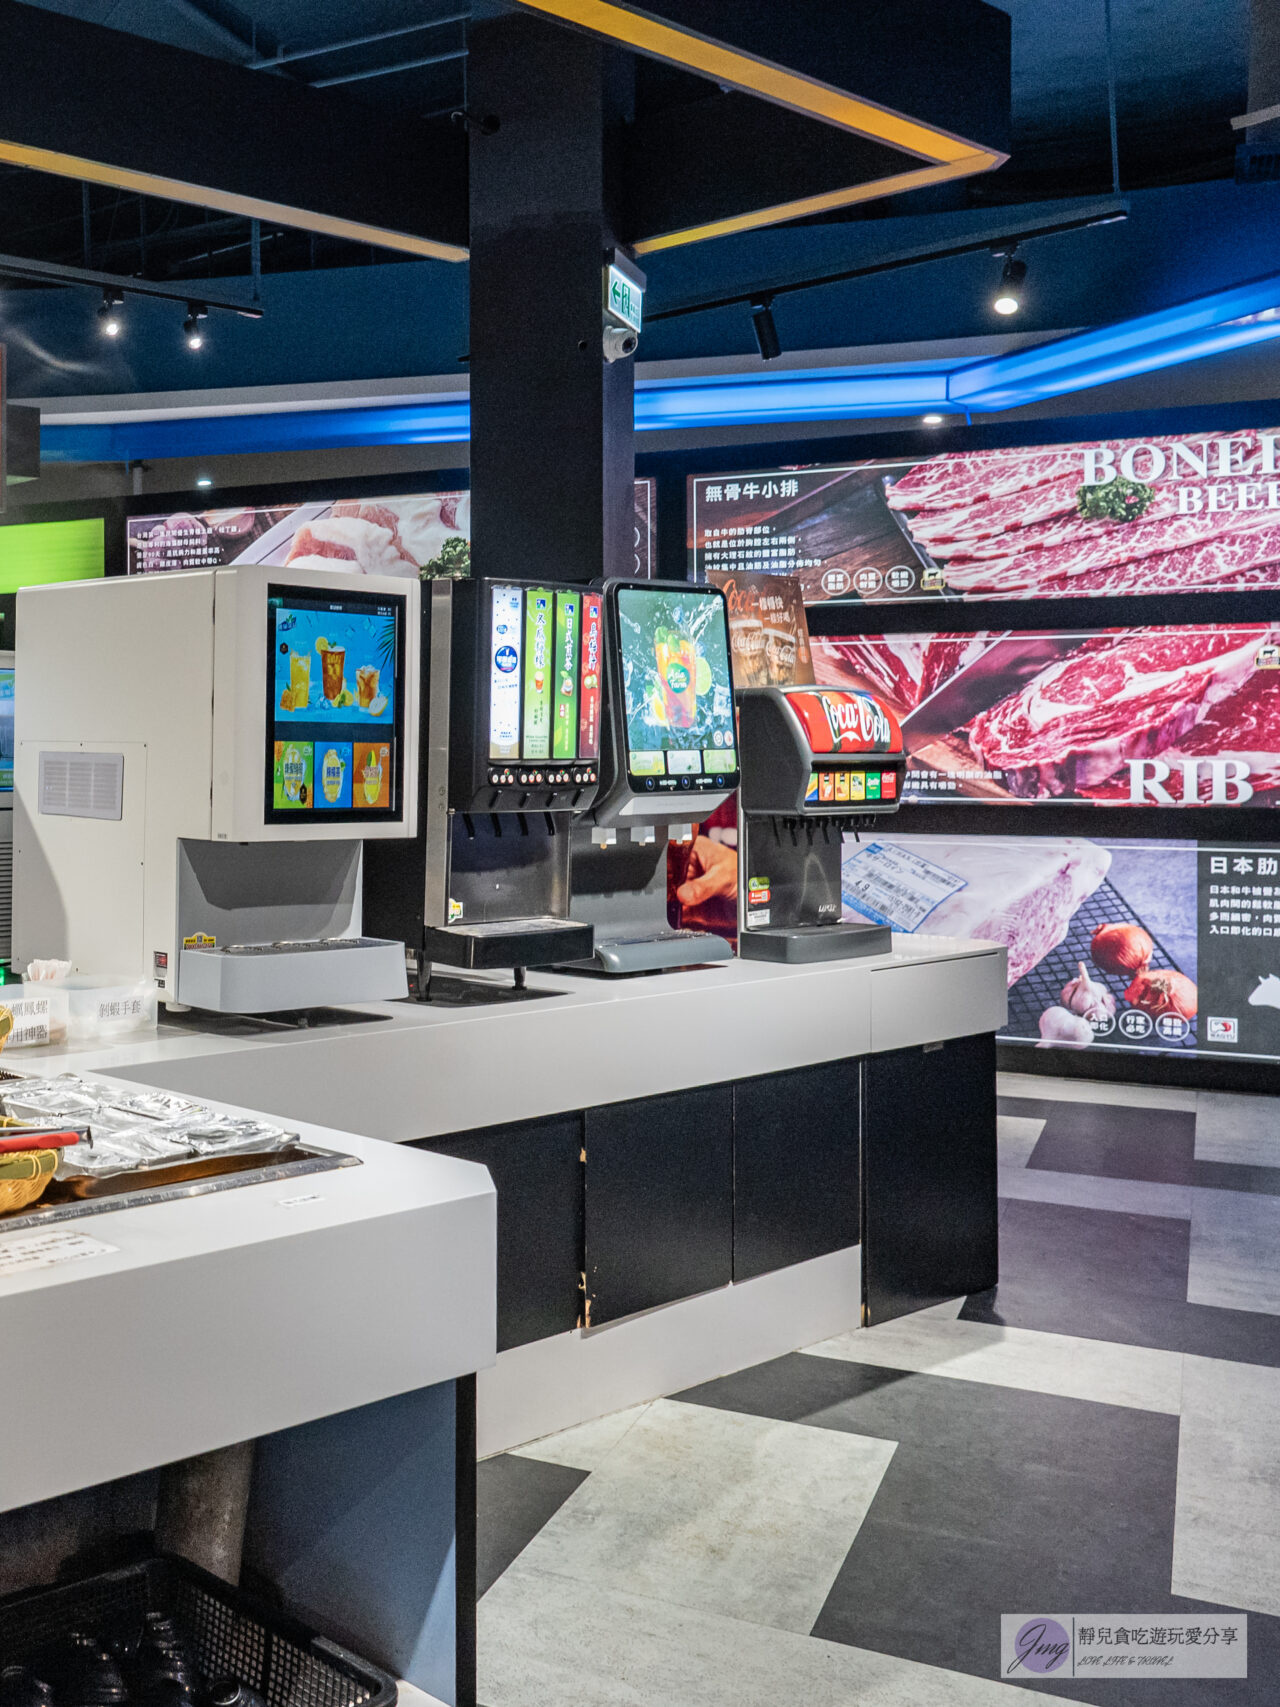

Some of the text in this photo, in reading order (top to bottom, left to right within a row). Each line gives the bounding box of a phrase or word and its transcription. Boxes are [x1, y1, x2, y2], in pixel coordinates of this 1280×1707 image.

[705, 479, 799, 502] 無骨牛小排
[1124, 758, 1254, 805] RIB
[1210, 856, 1278, 876] 日本肋
[4, 999, 48, 1017] 蠣鳳螺
